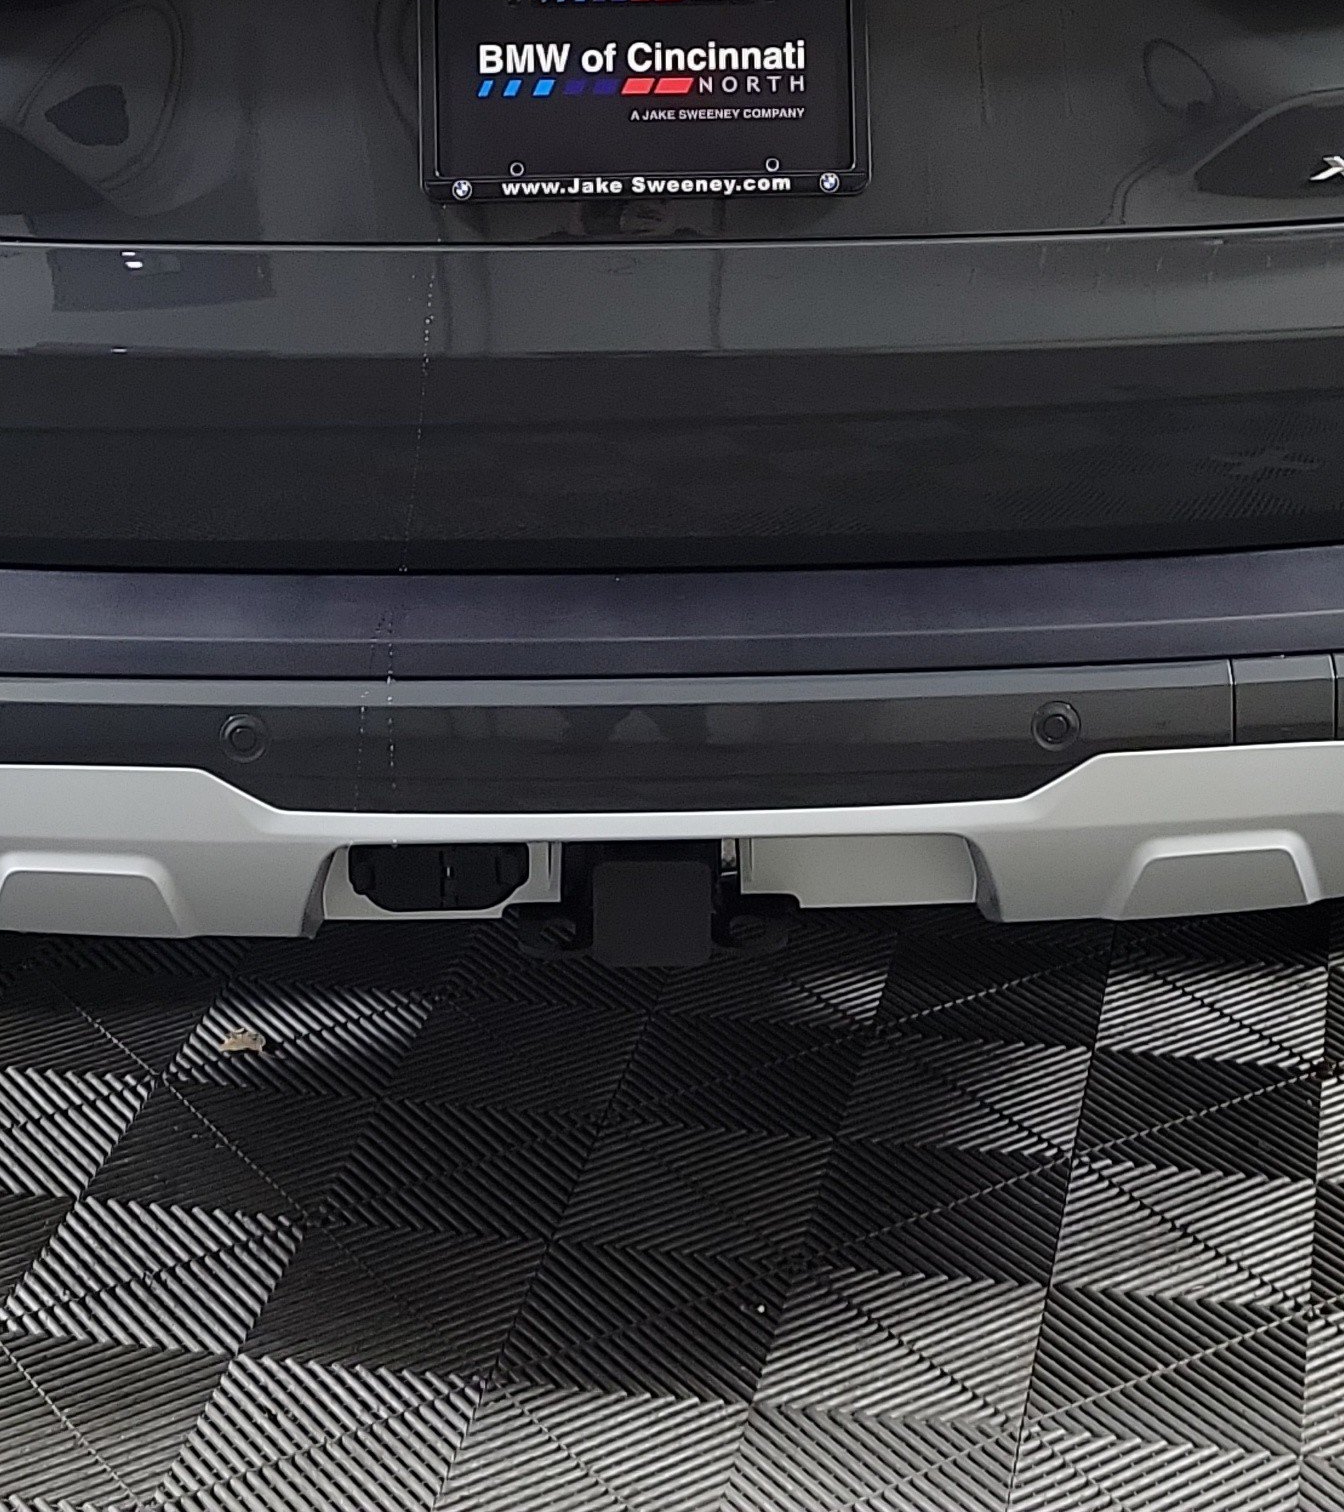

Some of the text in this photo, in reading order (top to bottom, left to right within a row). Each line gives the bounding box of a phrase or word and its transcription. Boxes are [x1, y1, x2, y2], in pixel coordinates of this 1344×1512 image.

[478, 40, 805, 74] BMW of Cincinnati
[699, 76, 805, 93] NORTH
[631, 107, 805, 121] A JAKE SWEENEY COMPANY
[502, 177, 792, 195] www.Jake Sweeney.com
